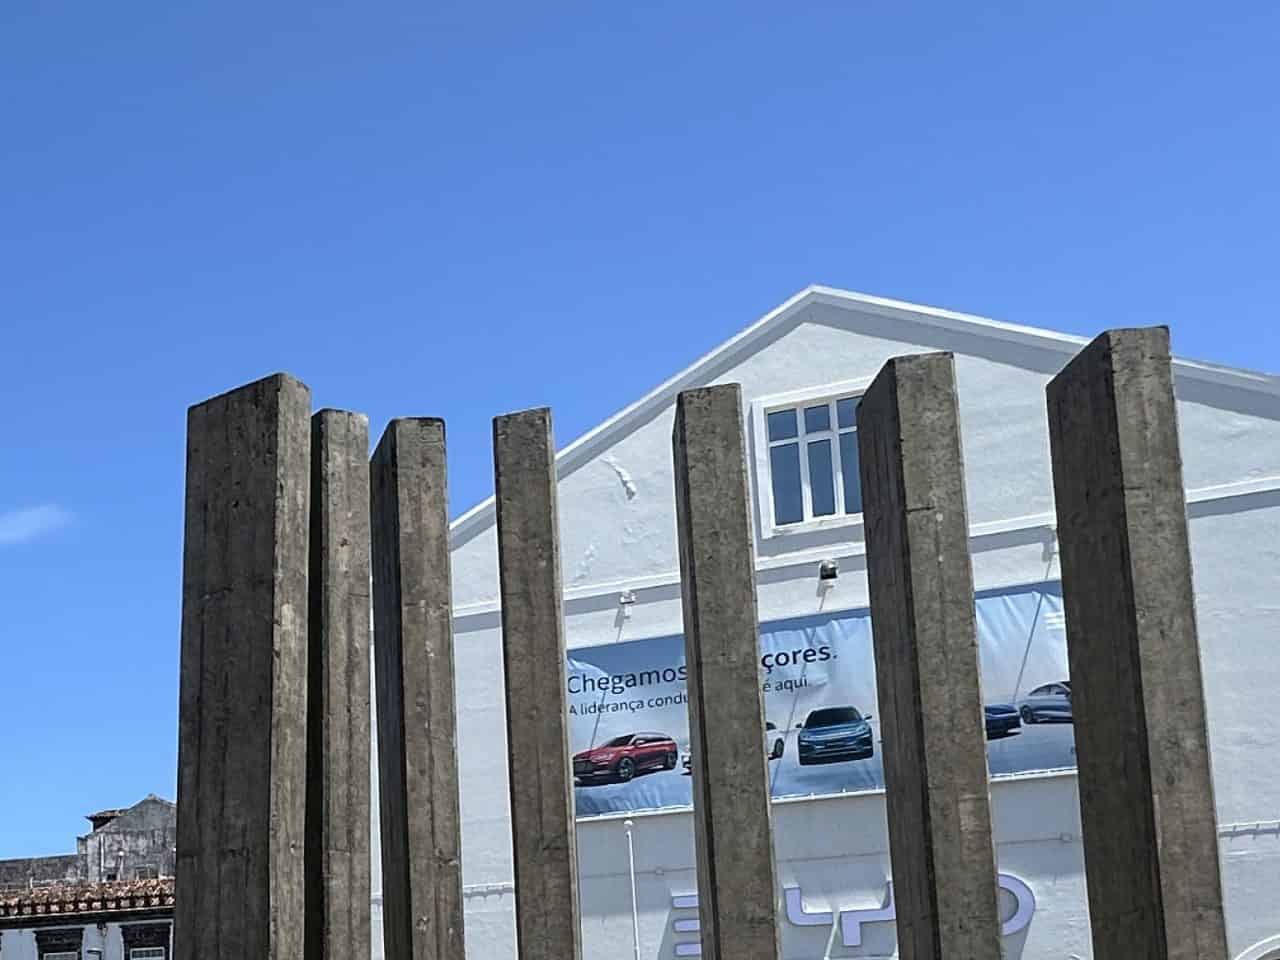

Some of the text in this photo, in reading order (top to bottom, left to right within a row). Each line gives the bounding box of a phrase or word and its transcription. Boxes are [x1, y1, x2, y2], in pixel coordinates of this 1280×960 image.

[568, 646, 838, 695] Chegamos çores.
[569, 704, 578, 716] A
[580, 699, 645, 716] liderança
